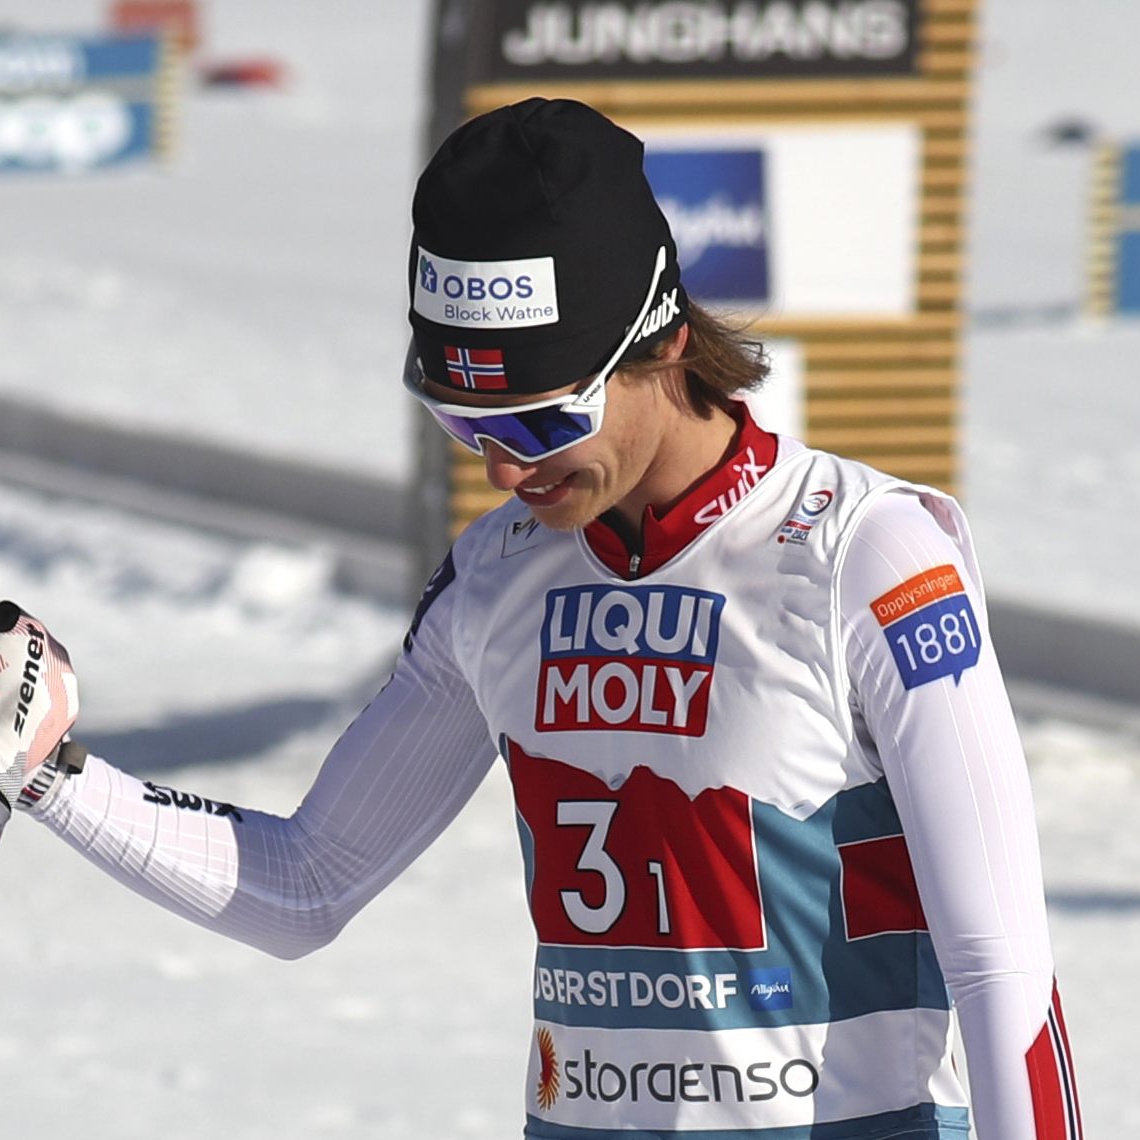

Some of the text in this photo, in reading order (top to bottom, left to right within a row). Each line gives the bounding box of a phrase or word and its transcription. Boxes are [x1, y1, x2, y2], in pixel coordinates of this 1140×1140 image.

[501, 1, 909, 65] JUNGHANS
[443, 276, 533, 301] OBOS
[444, 304, 554, 321] Block Watne
[549, 590, 714, 657] LIQUI
[896, 608, 977, 671] 1881
[13, 622, 45, 739] ziener
[543, 661, 710, 728] MOLY
[556, 799, 628, 935] 3
[564, 1049, 820, 1103] storaenso
